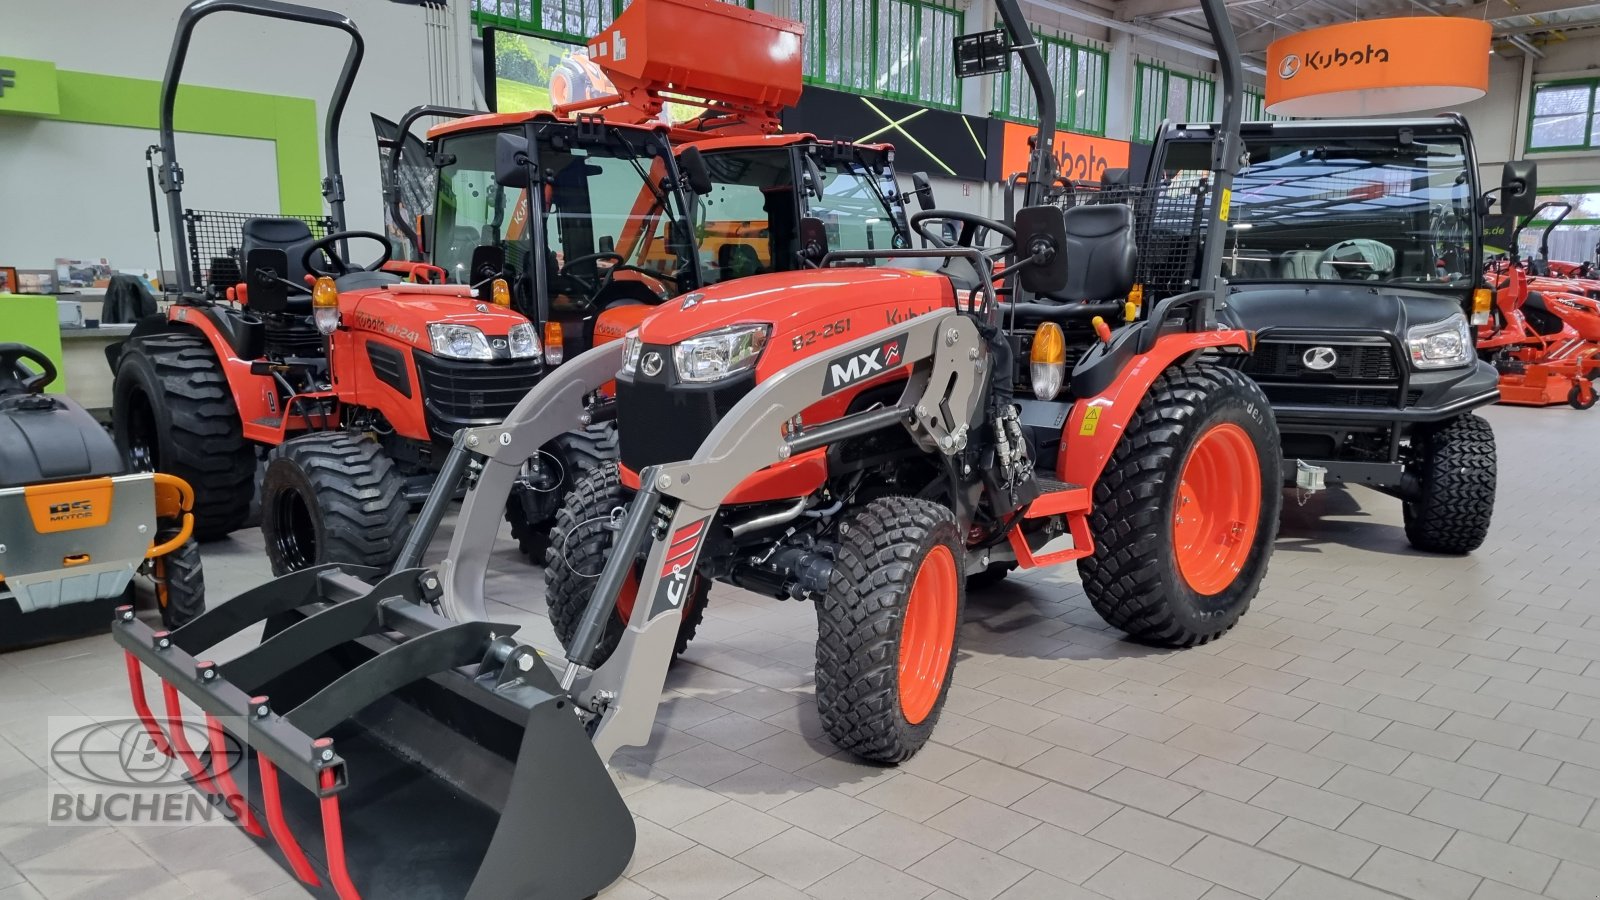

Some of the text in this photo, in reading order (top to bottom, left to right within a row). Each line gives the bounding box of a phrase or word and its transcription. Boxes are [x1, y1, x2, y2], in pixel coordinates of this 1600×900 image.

[1305, 44, 1389, 70] Kubota
[355, 311, 385, 333] Kubota
[792, 318, 851, 352] B2-261
[830, 347, 883, 388] MX
